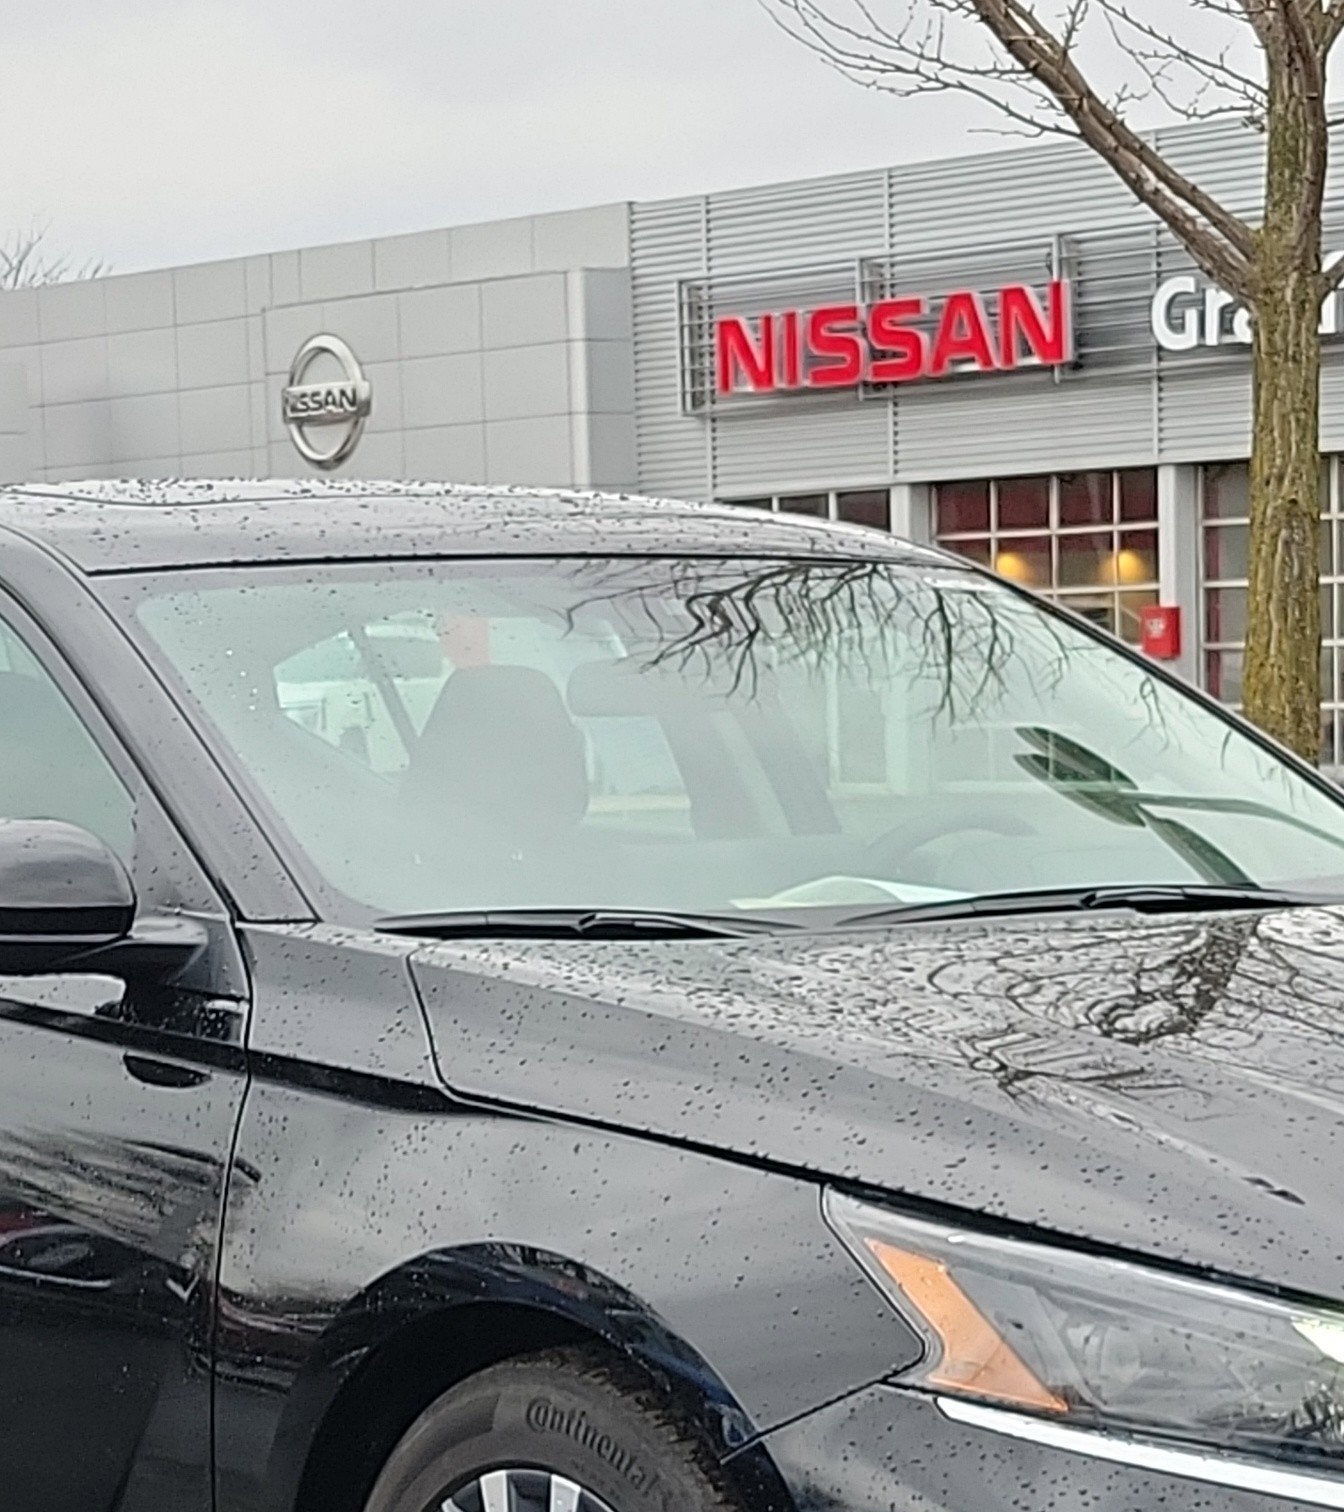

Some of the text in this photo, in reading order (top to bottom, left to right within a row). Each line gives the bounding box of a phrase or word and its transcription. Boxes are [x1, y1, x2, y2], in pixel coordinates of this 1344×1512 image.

[716, 279, 1067, 395] NISSAN
[286, 387, 357, 413] SSAN
[525, 1398, 658, 1497] Continental
